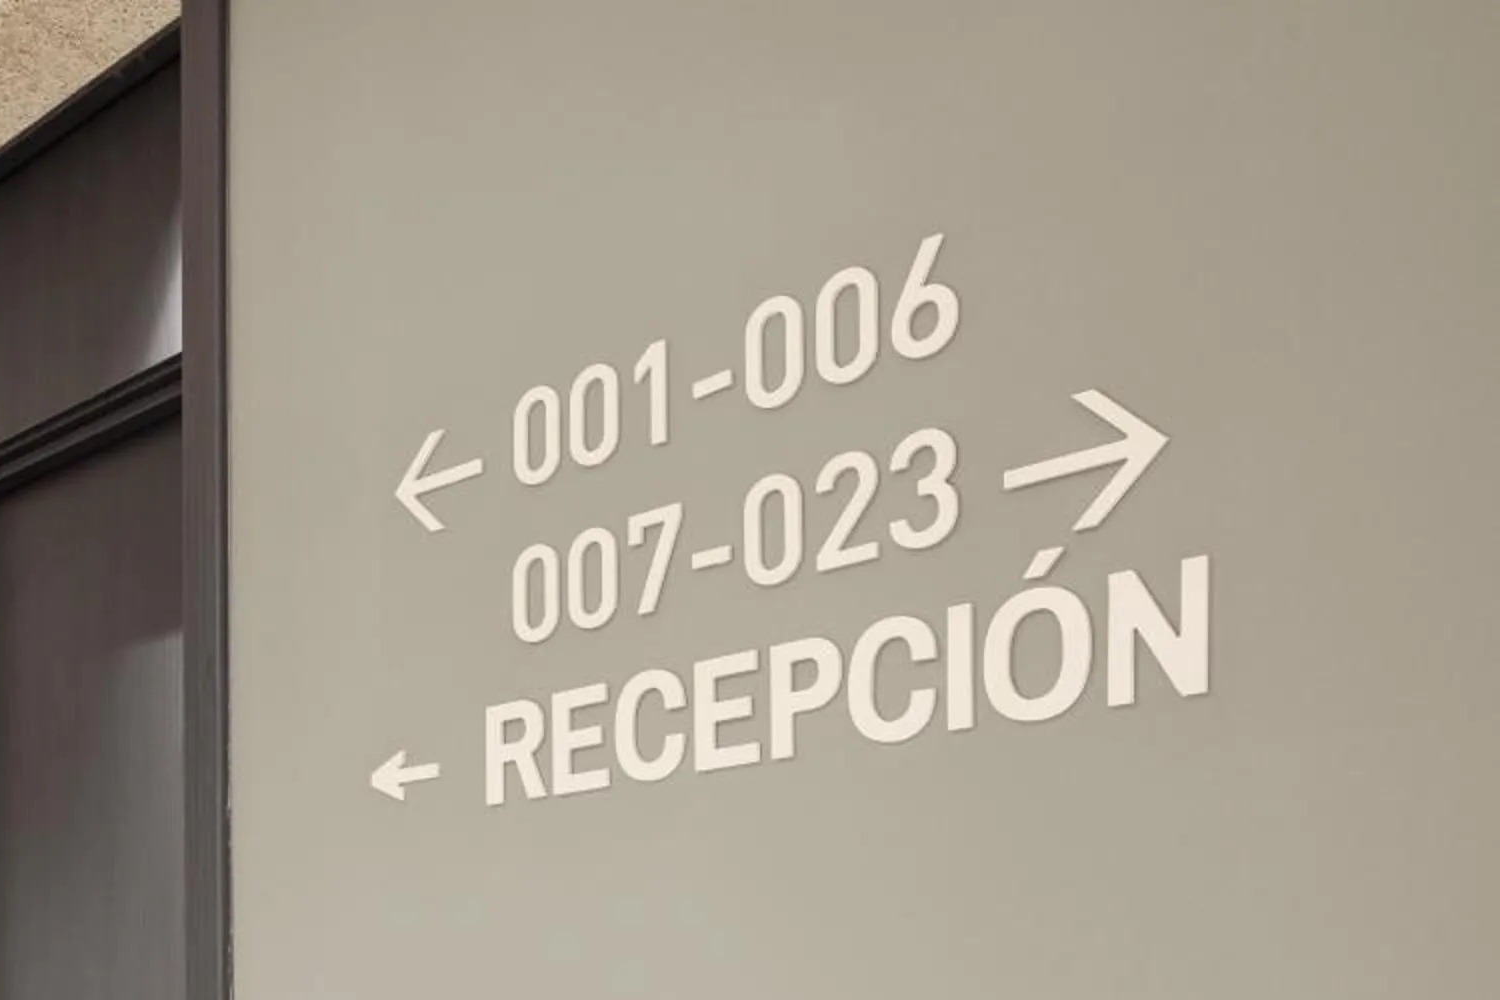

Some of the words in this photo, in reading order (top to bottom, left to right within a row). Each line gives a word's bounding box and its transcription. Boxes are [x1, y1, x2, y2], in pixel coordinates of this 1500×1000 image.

[512, 232, 960, 486] 001-006
[512, 427, 960, 644] 007-023
[485, 545, 1210, 806] RECEPCIÓN
